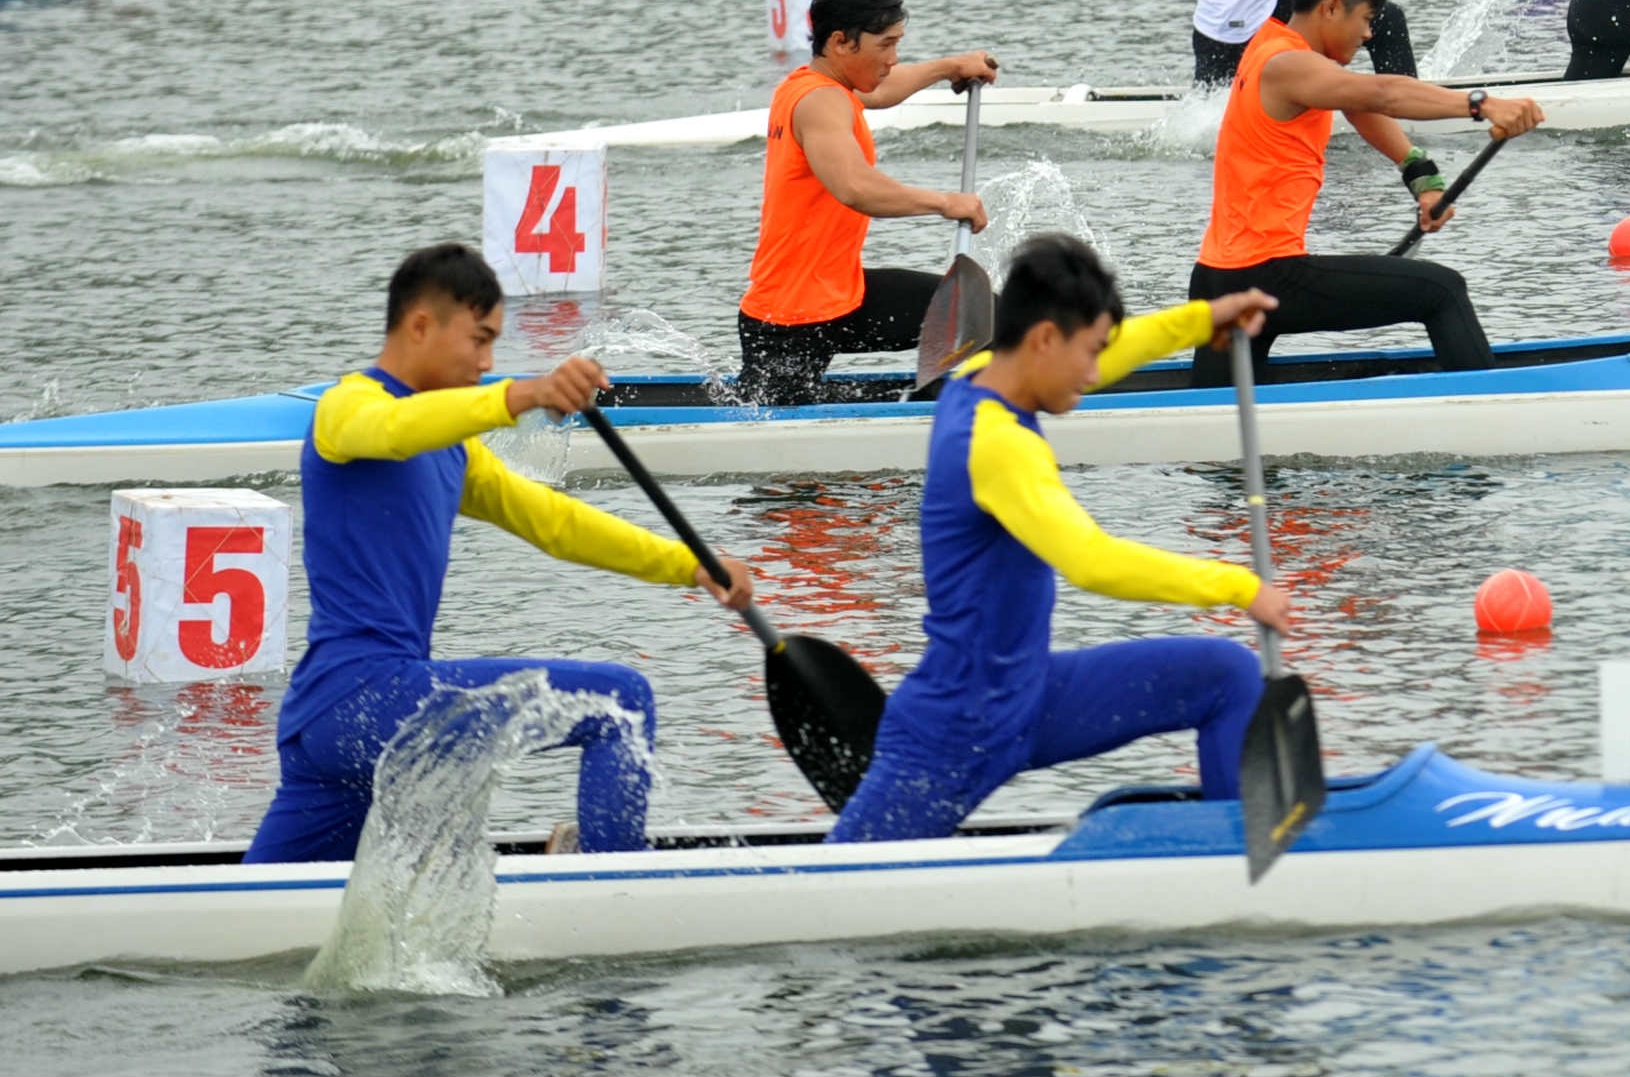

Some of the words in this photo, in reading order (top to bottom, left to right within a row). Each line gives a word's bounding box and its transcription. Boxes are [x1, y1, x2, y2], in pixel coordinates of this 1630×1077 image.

[515, 165, 586, 273] 4
[113, 514, 143, 662] 5
[177, 527, 265, 669] 5
